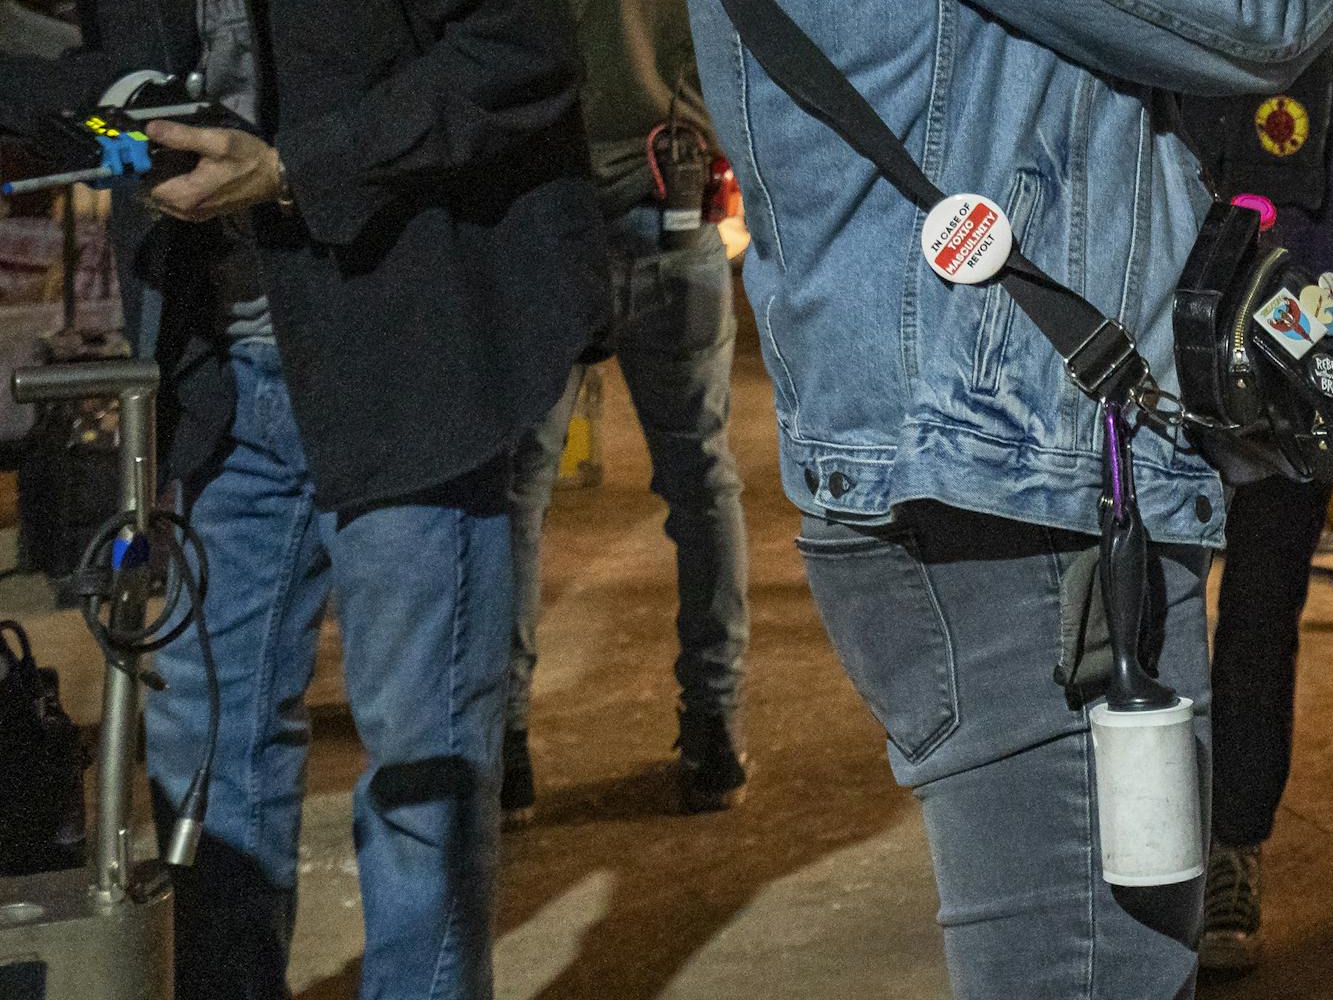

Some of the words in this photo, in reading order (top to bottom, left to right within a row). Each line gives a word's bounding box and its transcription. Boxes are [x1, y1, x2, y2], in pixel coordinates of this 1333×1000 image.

[931, 238, 942, 252] IN
[940, 216, 961, 240] CASE
[959, 202, 970, 216] OF
[946, 212, 995, 273] MASCULINITY
[947, 220, 973, 250] TOXIC
[967, 233, 995, 268] REVOLT
